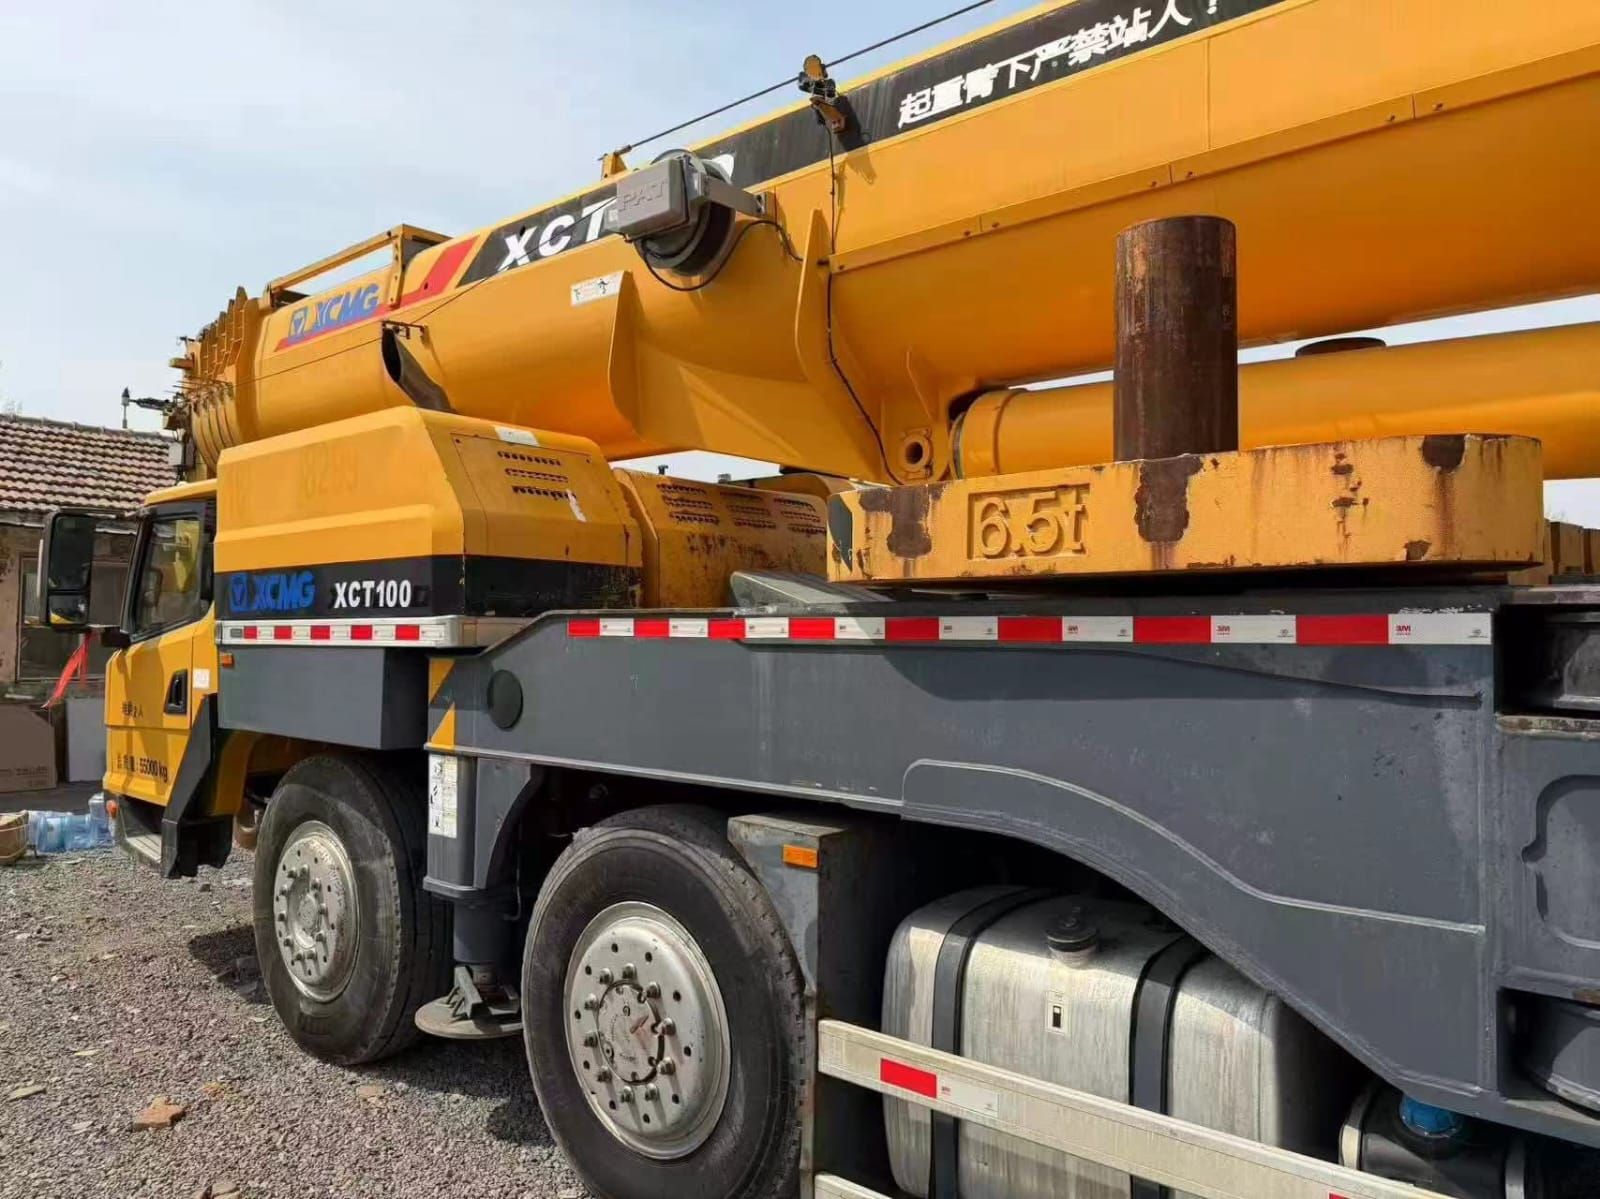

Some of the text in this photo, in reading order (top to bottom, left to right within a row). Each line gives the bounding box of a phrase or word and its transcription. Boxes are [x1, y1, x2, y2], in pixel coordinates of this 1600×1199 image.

[312, 283, 379, 332] XCMG
[981, 488, 1087, 556] 6.5t
[252, 571, 315, 611] XCMG
[334, 580, 412, 608] XCT100
